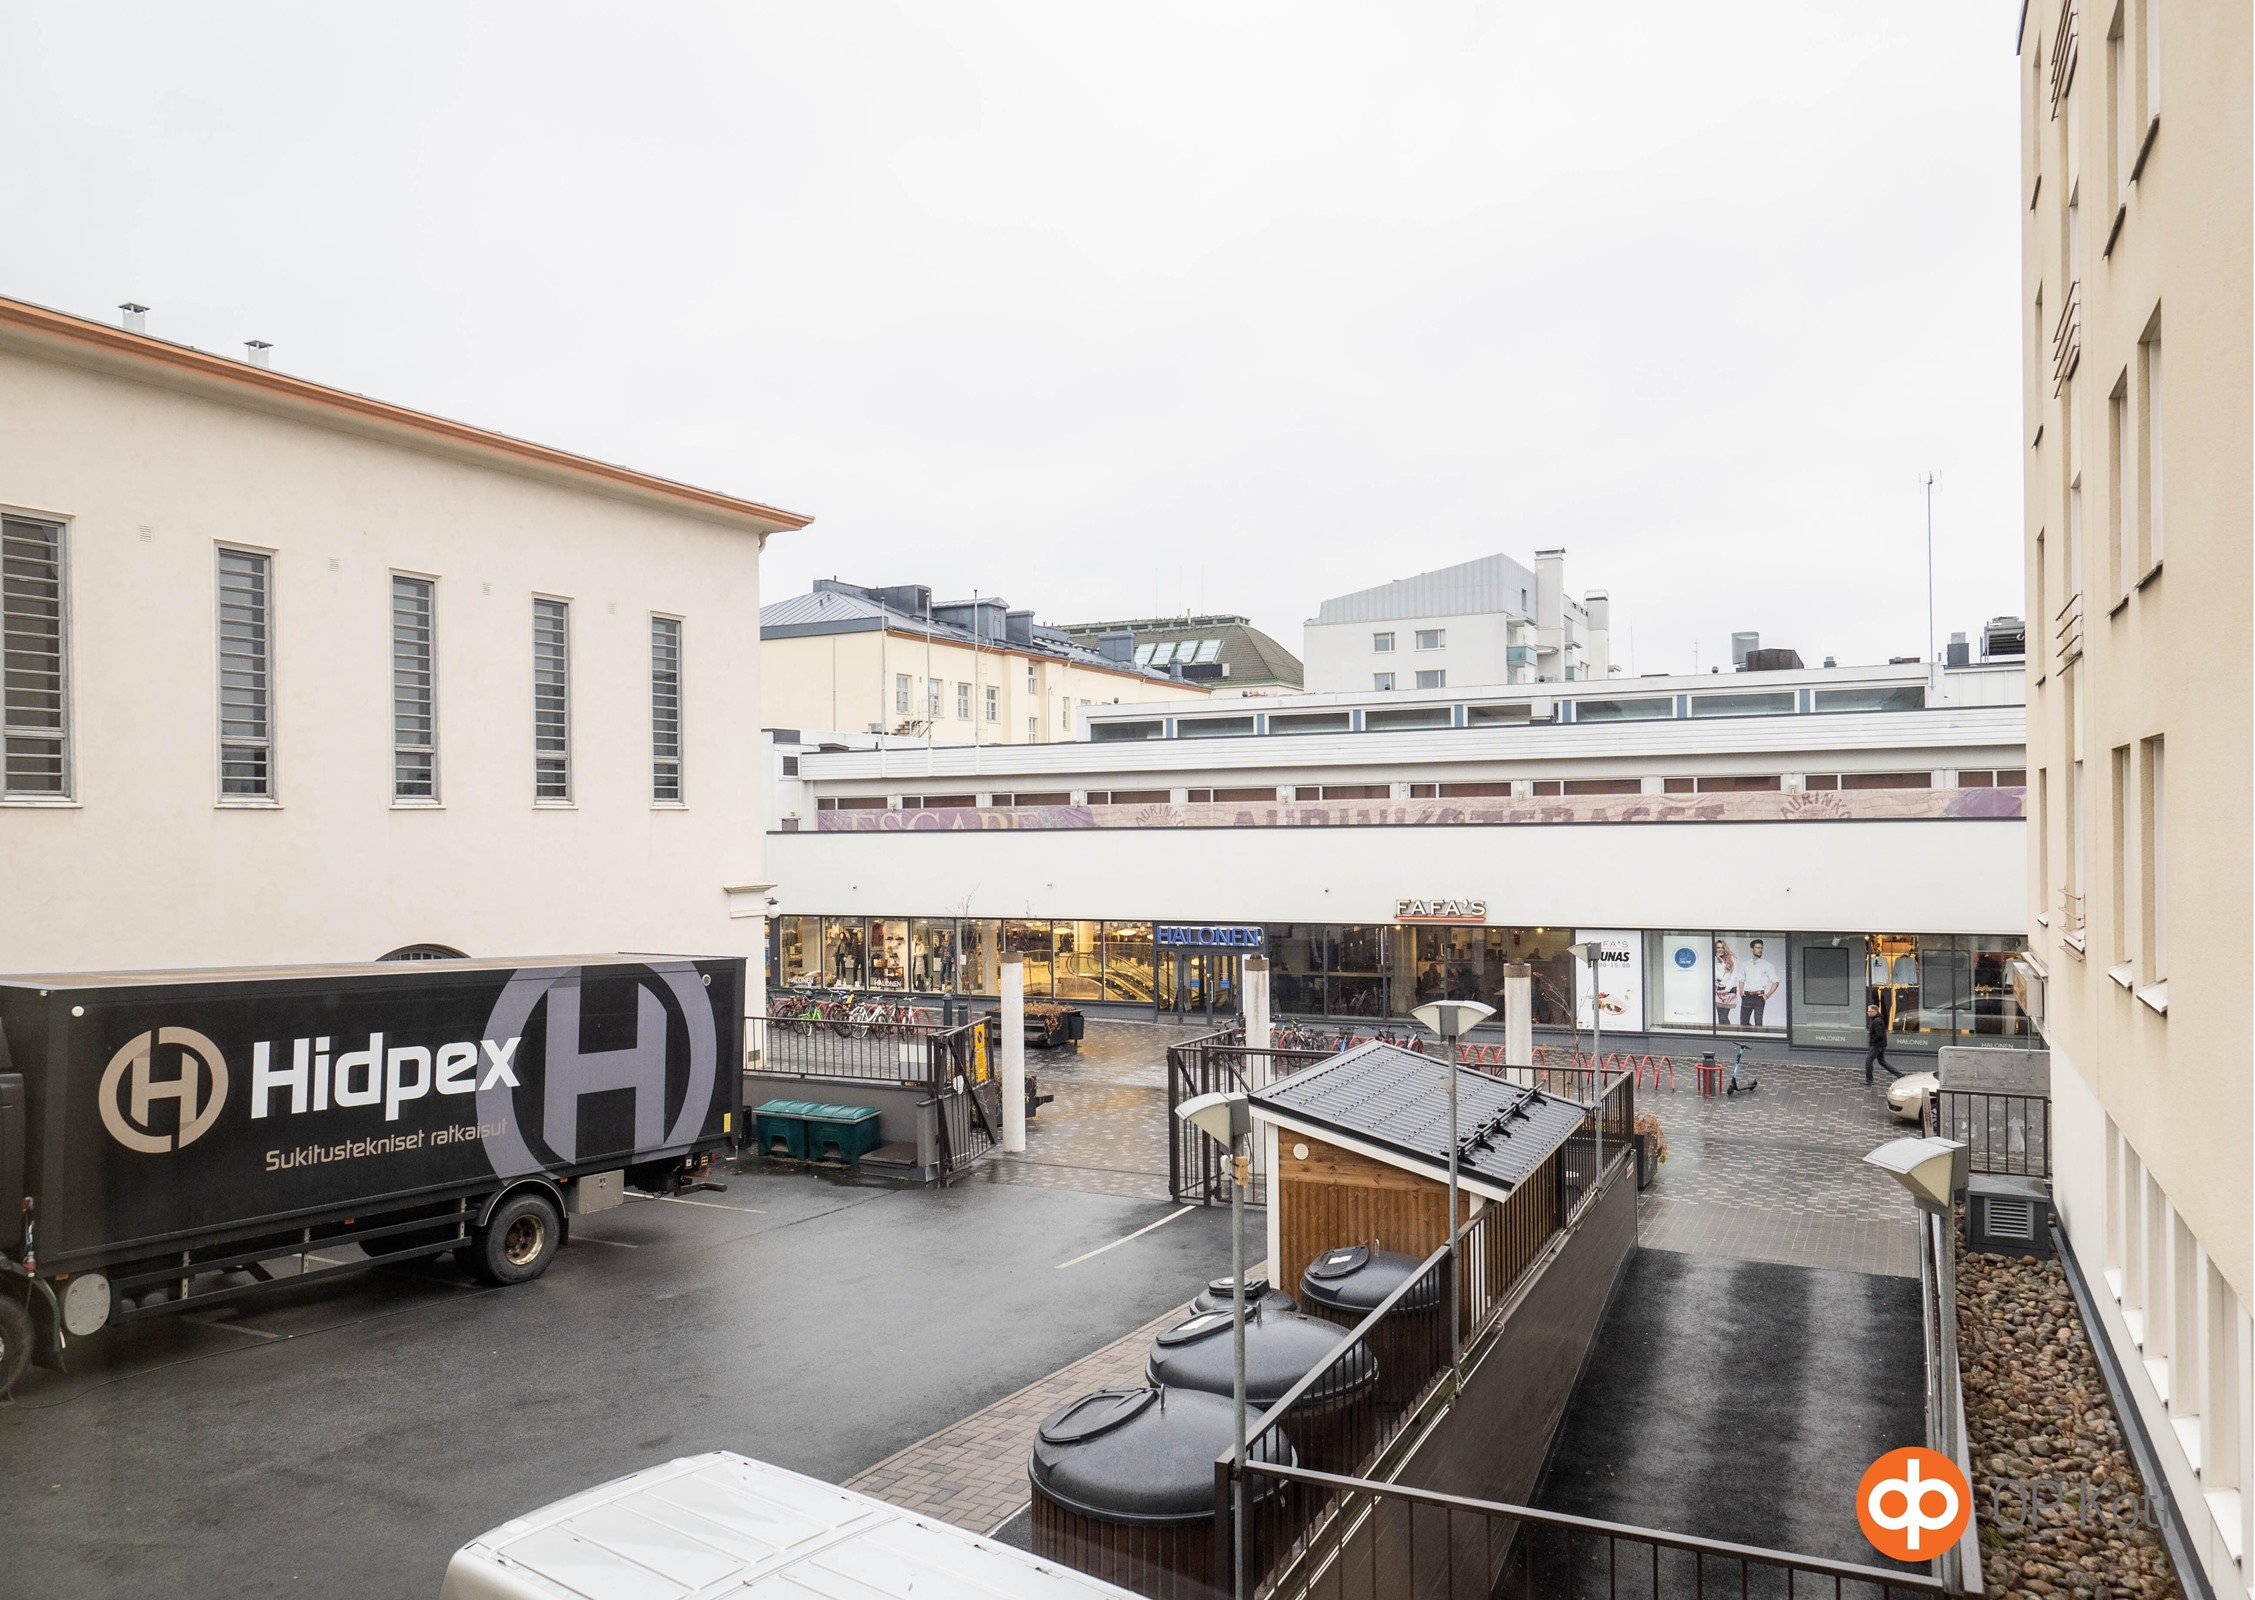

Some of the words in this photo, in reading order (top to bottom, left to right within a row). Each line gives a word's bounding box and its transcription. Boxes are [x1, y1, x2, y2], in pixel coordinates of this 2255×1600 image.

[1396, 899, 1487, 916] FAFA'S
[1157, 926, 1260, 946] HALONEN
[251, 1032, 521, 1122] Hidpex
[266, 1130, 425, 1171] Sukitustekniset
[430, 1118, 508, 1146] ratkaisut
